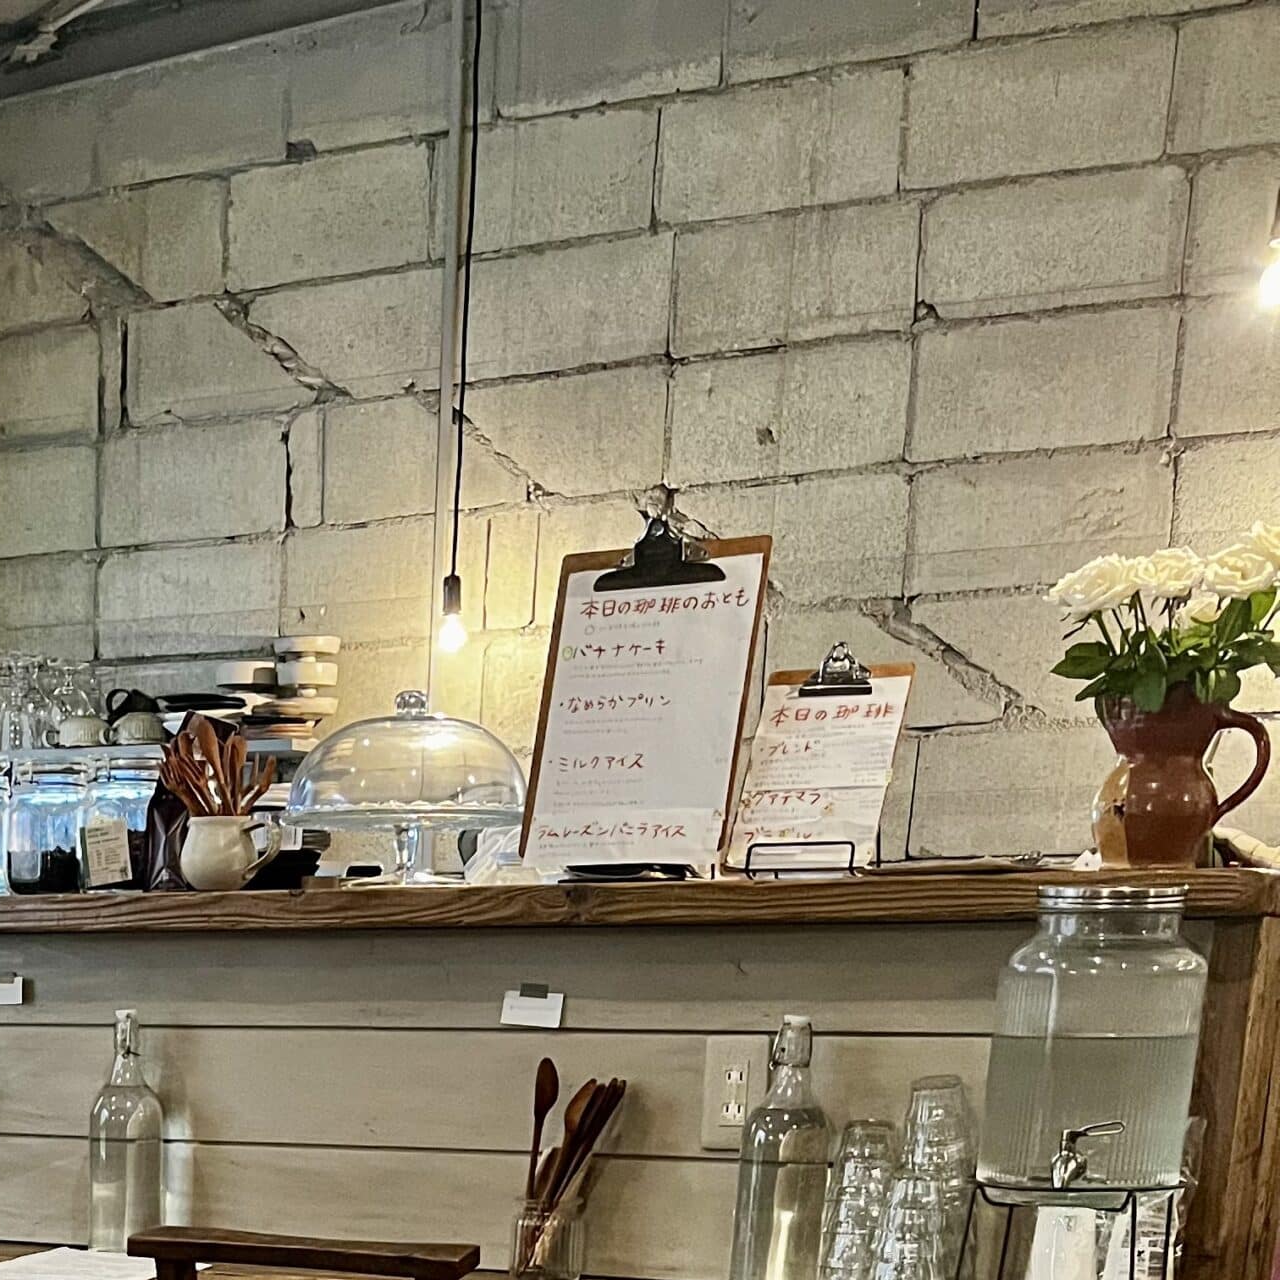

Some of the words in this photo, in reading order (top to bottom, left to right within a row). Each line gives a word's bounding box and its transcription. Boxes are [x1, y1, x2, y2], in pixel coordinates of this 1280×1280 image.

[580, 586, 750, 619] 本日の珈琲のおとも
[572, 639, 666, 660] バナナケーキ
[568, 693, 671, 714] なめらかプリン
[770, 701, 895, 727] 本日の珈琲
[559, 753, 645, 773] ミルクアイス
[535, 820, 687, 841] ラムレーズンバニラアイス
